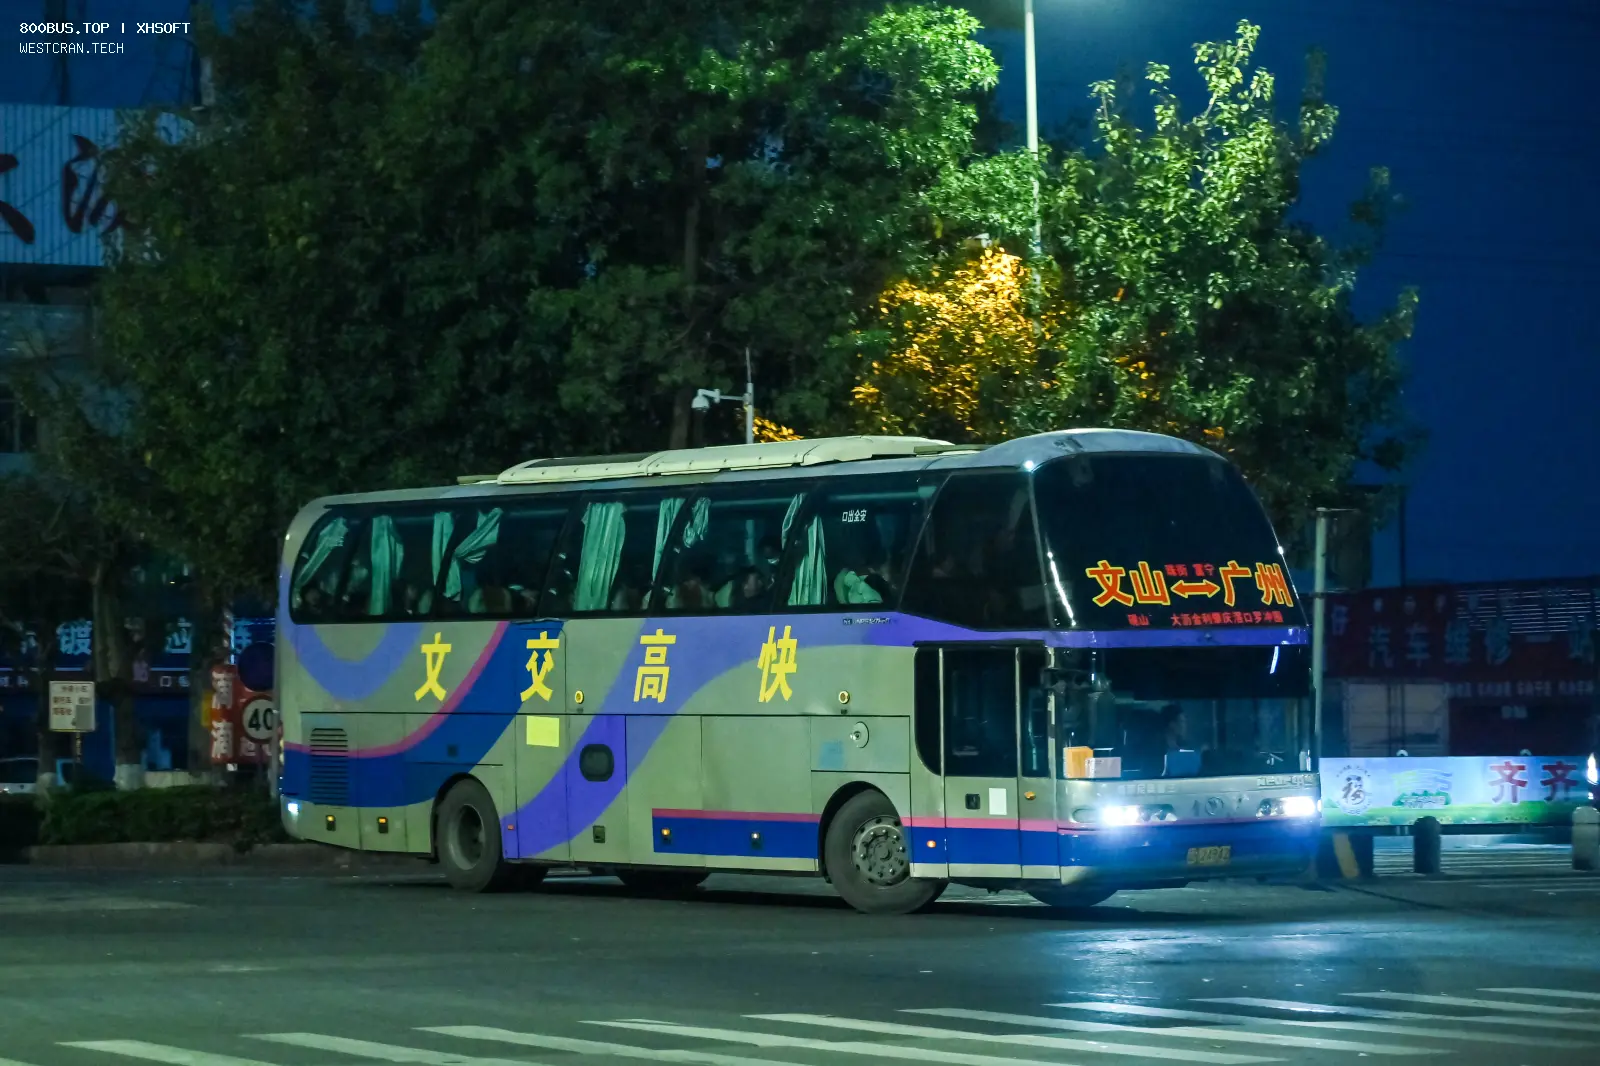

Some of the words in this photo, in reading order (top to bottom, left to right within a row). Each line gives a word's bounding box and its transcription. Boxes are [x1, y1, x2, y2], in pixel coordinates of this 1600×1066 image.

[1085, 559, 1171, 607] 文山
[1219, 559, 1294, 608] 广州
[413, 624, 799, 704] 文交高快
